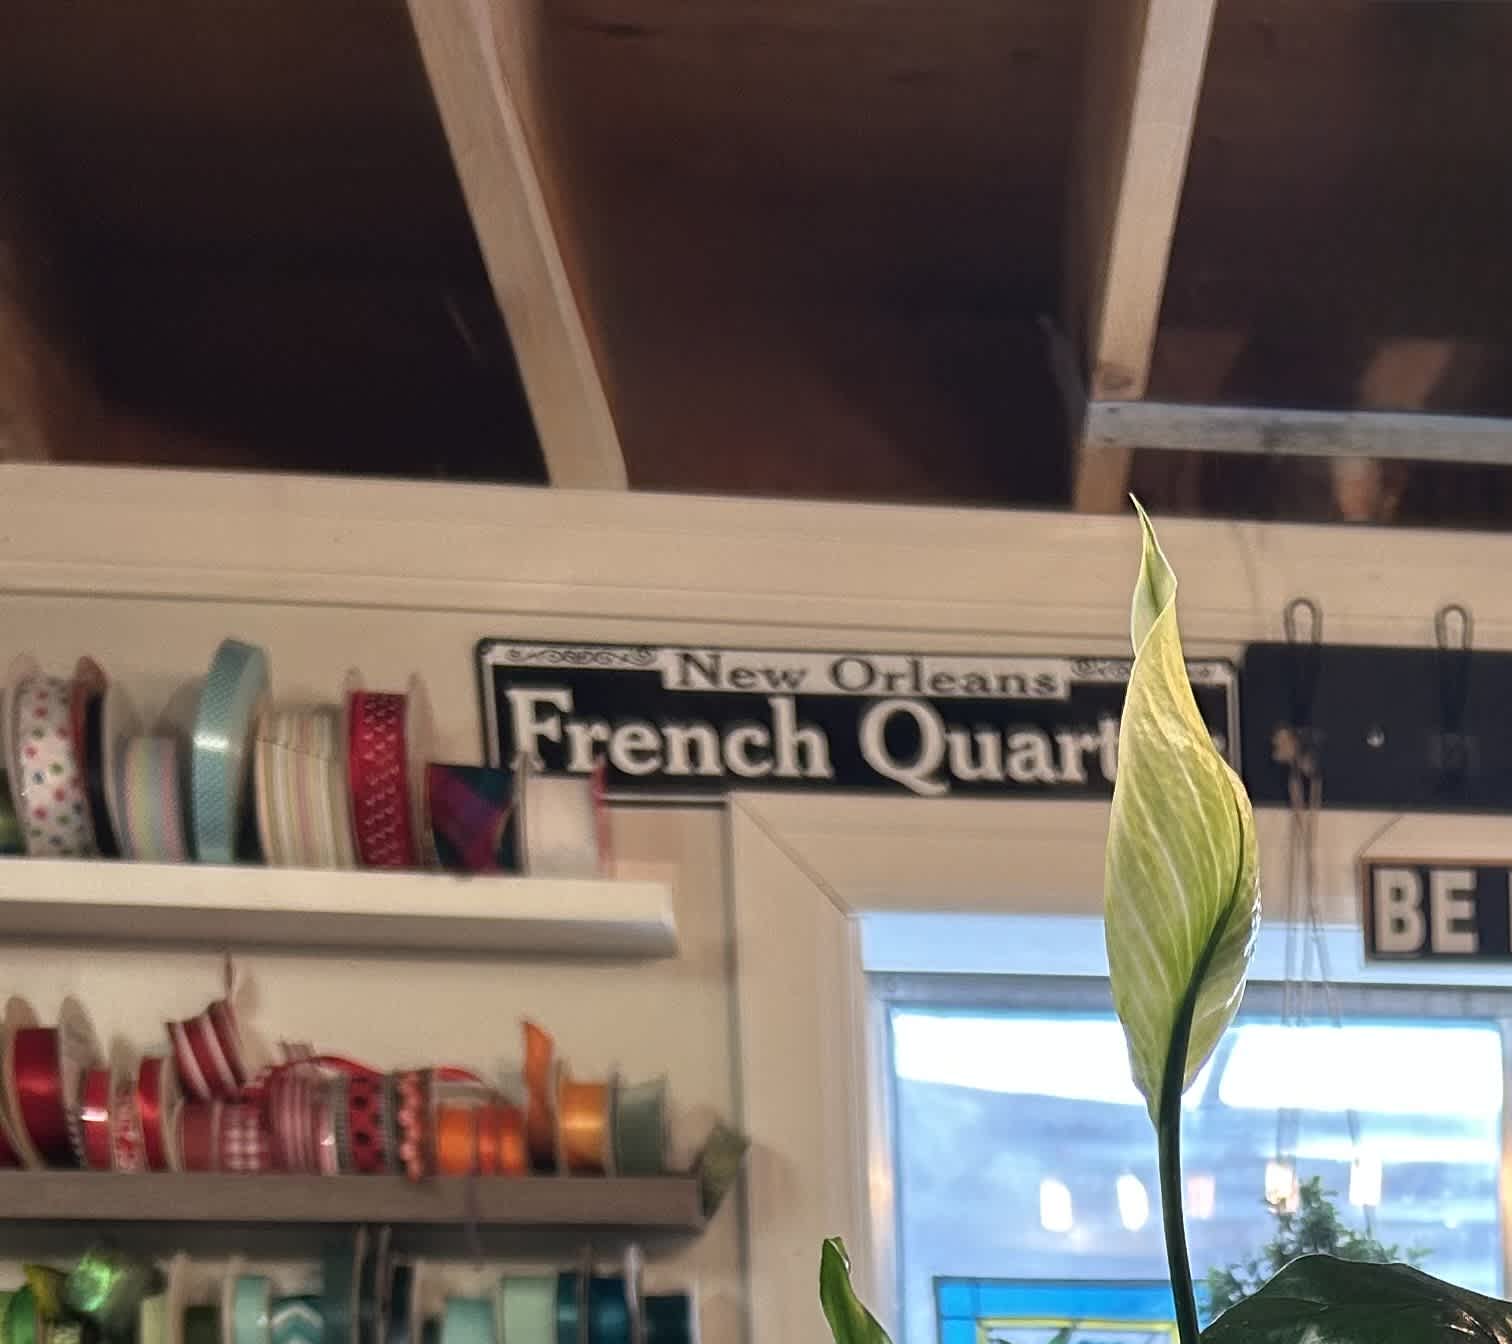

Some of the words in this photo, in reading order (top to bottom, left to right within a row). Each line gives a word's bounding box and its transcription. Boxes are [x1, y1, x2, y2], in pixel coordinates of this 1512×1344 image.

[676, 651, 807, 690] New
[828, 654, 1059, 698] Orleans
[505, 687, 834, 780] French
[857, 697, 1122, 797] Quart
[1370, 868, 1478, 954] BE
